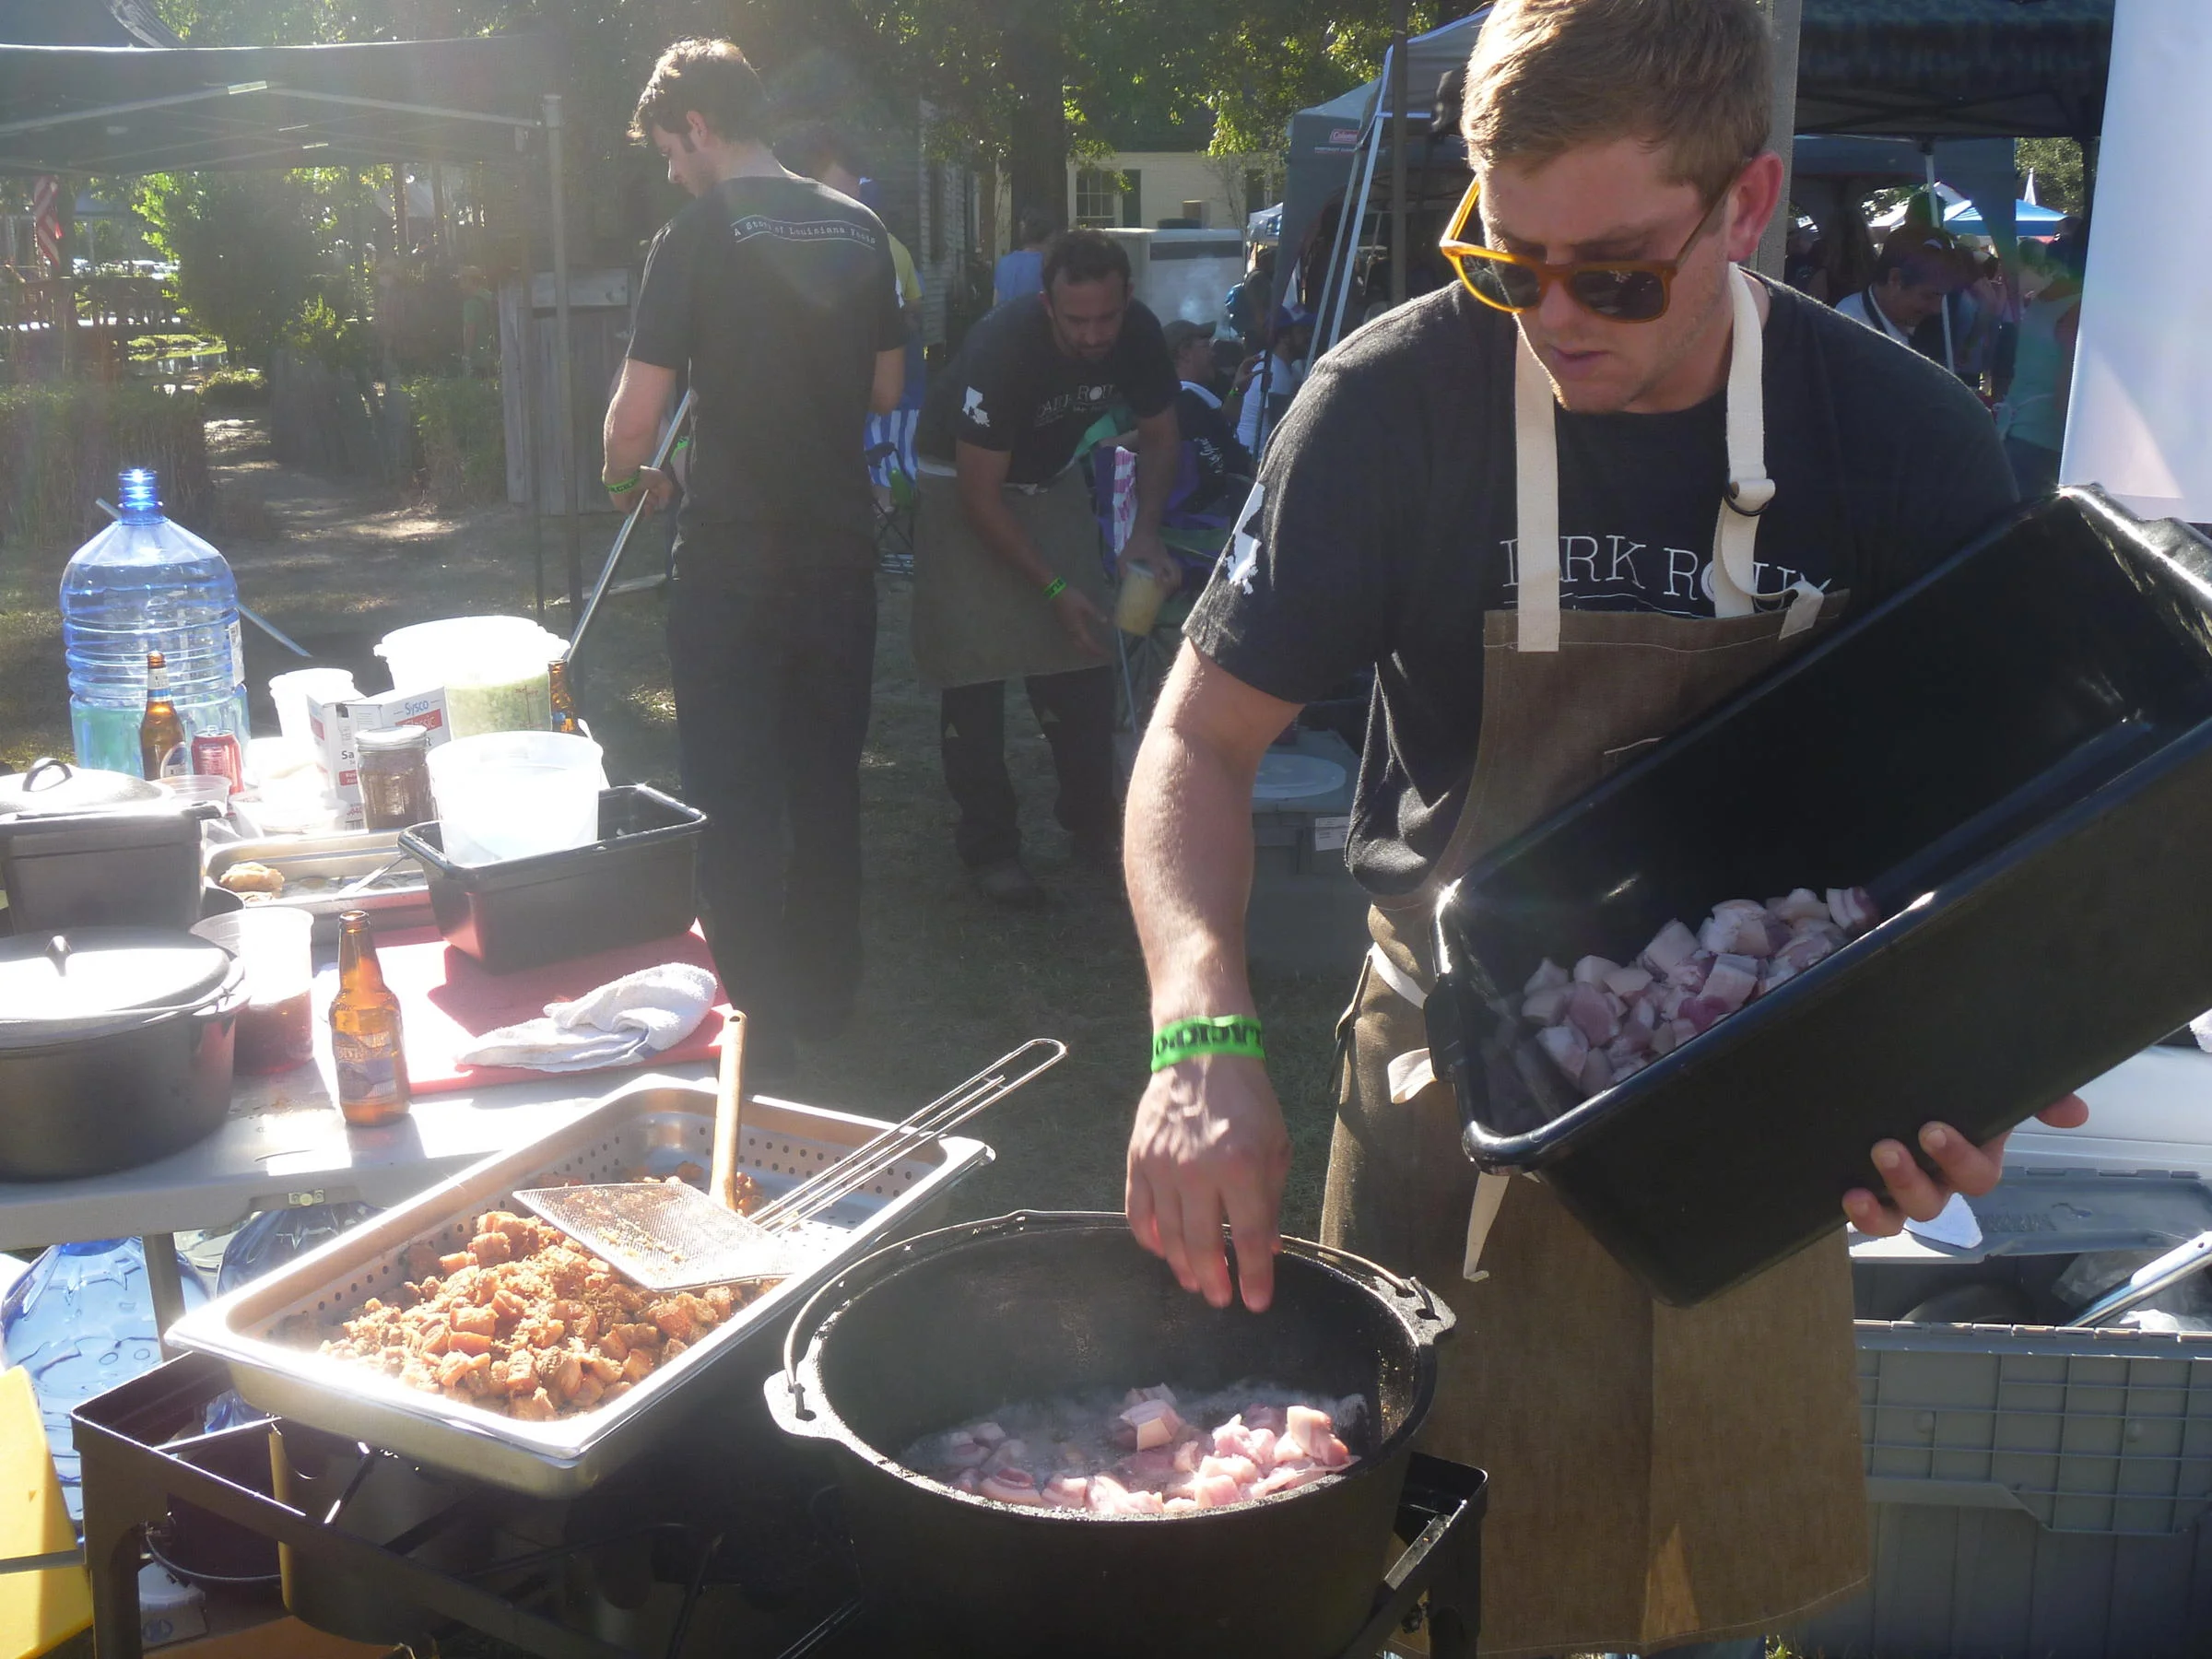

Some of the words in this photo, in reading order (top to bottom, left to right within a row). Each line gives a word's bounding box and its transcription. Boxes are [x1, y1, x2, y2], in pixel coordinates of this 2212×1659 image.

[789, 226, 845, 236] Louisiana
[1500, 535, 1646, 589] RK
[405, 700, 429, 716] Sysco
